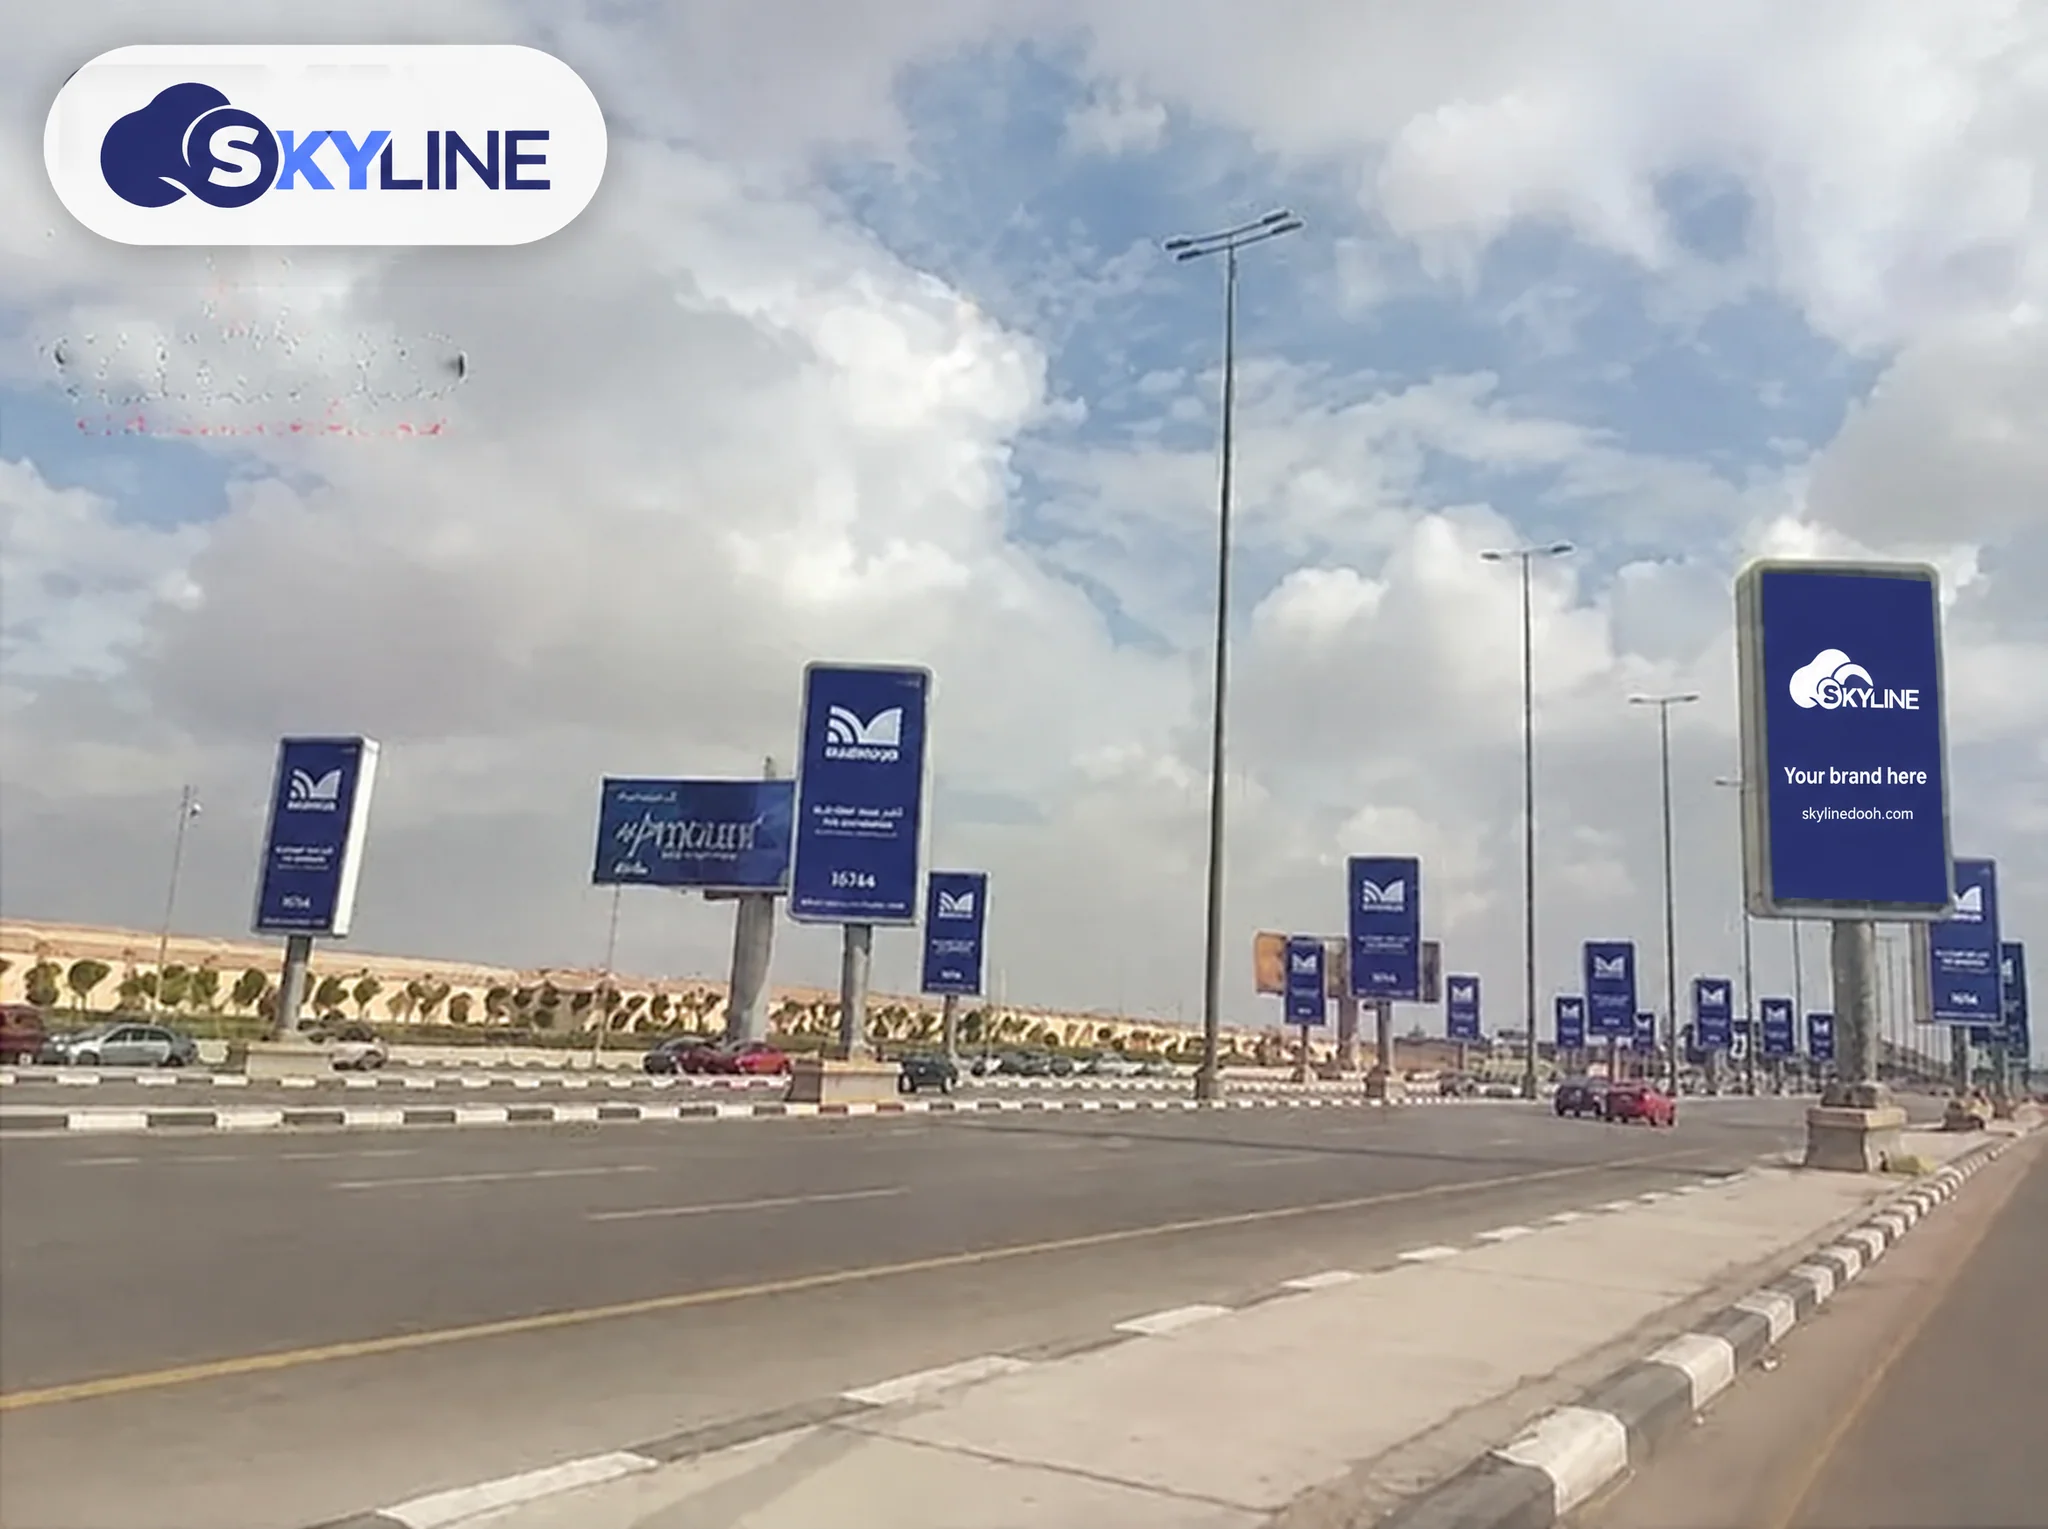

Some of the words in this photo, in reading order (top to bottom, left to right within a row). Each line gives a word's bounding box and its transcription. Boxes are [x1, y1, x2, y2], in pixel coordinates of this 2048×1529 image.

[1823, 685, 1920, 710] SKYLINE
[1783, 766, 1826, 785] Your
[1829, 766, 1882, 785] brand
[1887, 766, 1928, 785] here
[1802, 807, 1914, 823] skylinedooh.com
